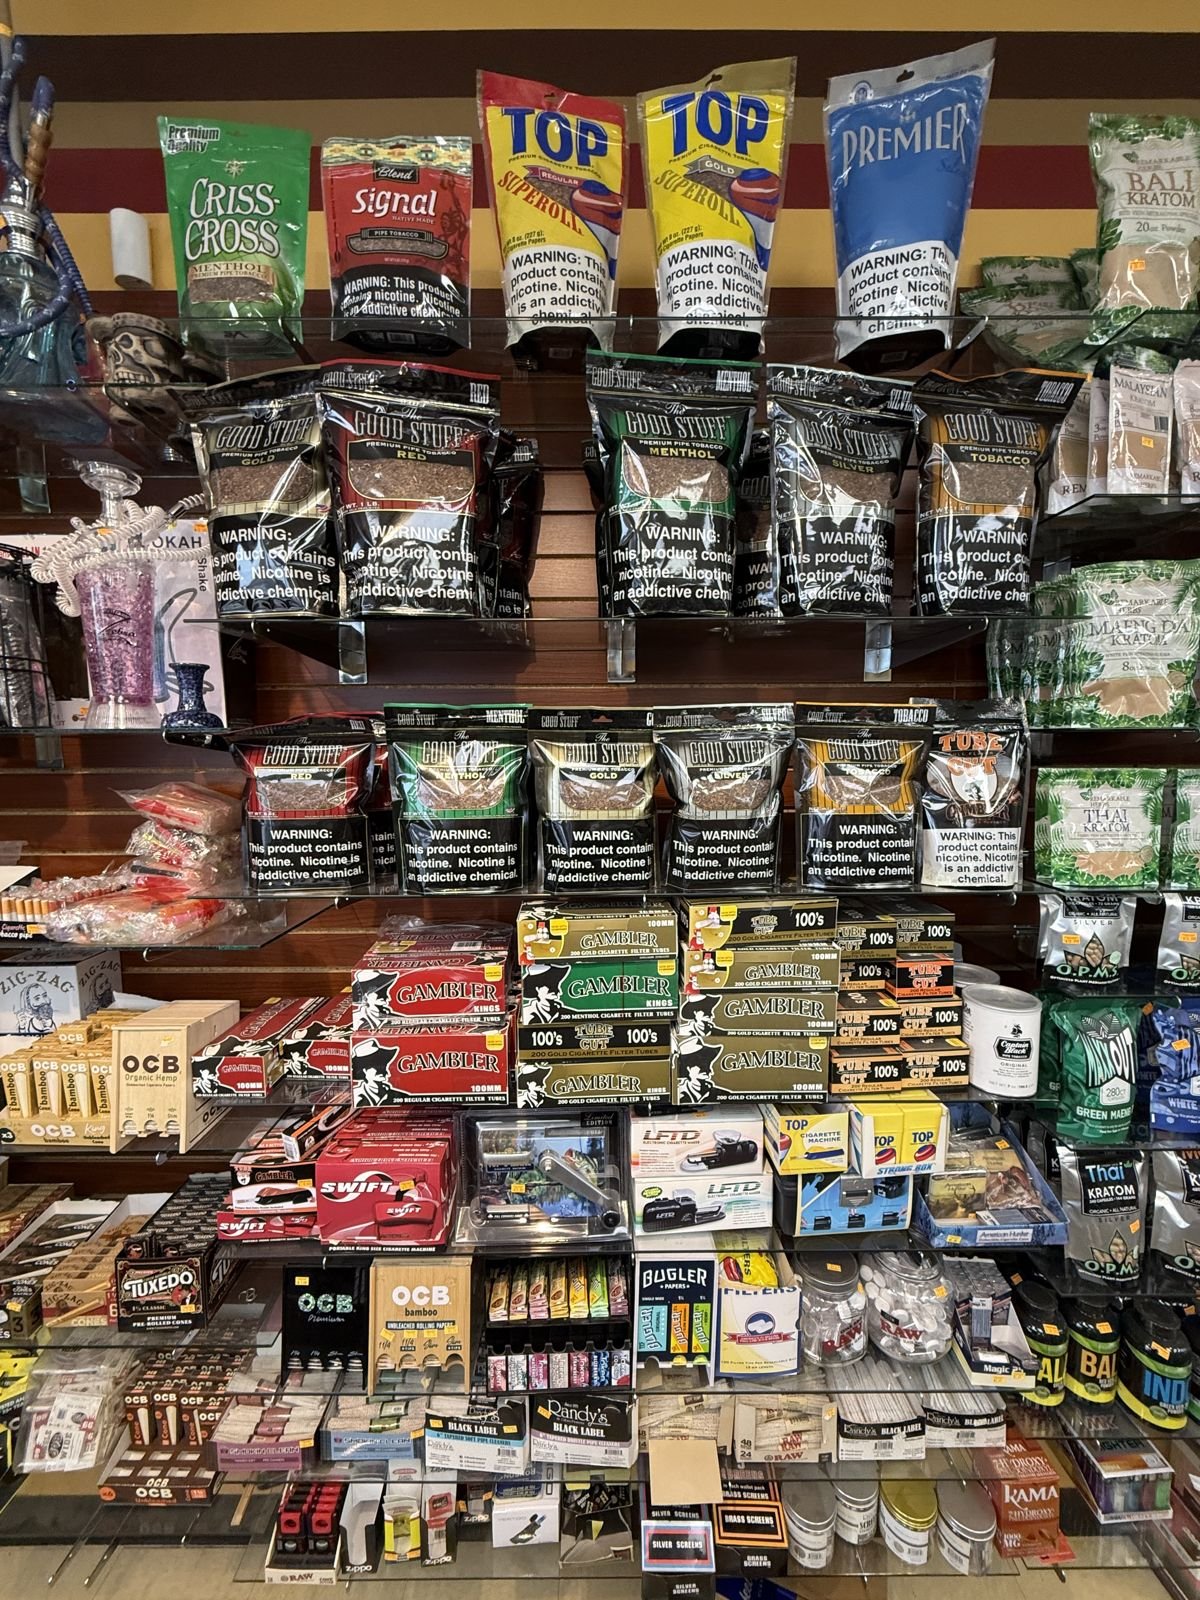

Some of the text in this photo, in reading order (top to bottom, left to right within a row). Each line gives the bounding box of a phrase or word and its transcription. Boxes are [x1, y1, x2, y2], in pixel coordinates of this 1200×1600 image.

[662, 91, 769, 156] TOP
[169, 126, 219, 140] Premium
[501, 107, 608, 166] TOP
[168, 139, 206, 152] Quality
[842, 103, 967, 186] PREMIER
[379, 167, 412, 180] Blend
[705, 160, 735, 175] GOLD
[541, 171, 579, 185] REGULAR
[1129, 170, 1193, 192] BALI
[352, 188, 437, 217] Signal
[497, 170, 584, 236] SUPEROLL
[654, 169, 742, 227] SUPEROLL
[1127, 192, 1194, 209] KRATOM
[184, 218, 280, 260] CROSS
[511, 251, 581, 268] WARNING:
[667, 246, 758, 274] WARNING: This
[850, 249, 927, 280] WARNING:
[511, 266, 557, 291] product
[344, 277, 415, 295] WARNING: This
[1114, 377, 1168, 398] MALAYSIAN
[216, 416, 314, 449] GOOD STUFF
[355, 410, 463, 448] GOOD STUFF
[627, 411, 726, 441] GOOD STUFF
[944, 414, 1041, 447] GOOD STUFF
[691, 442, 723, 450] TOBACCO
[242, 454, 275, 466] GOLD
[396, 450, 427, 462] RED
[649, 448, 715, 460] MENTHOL
[970, 453, 1030, 465] TOBACCO
[832, 459, 874, 474] SILVER
[646, 526, 720, 543] WARNING:
[198, 557, 206, 592] Shake
[1089, 618, 1189, 636] MAENG DA
[486, 710, 525, 724] MENTHOL
[893, 709, 929, 723] TOBACCO
[594, 733, 610, 742] The
[939, 732, 1004, 751] TUBE
[263, 745, 343, 765] GOOD STUFF
[564, 744, 640, 764] GOOD STUFF
[690, 741, 764, 764] GOOD STUFF
[291, 772, 312, 780] RED
[590, 771, 617, 779] GOLD
[1083, 808, 1127, 824] THAI
[270, 829, 333, 839] WARNING:
[430, 829, 491, 839] WARNING:
[573, 831, 633, 841] WARNING:
[702, 830, 758, 840] WARNING:
[840, 824, 897, 834] WARNING:
[940, 832, 1016, 841] WARNING: This
[268, 841, 362, 855] product contains
[405, 842, 517, 856] This product contains
[300, 853, 360, 867] Nicotine is
[258, 868, 364, 880] addictive chemical.
[958, 874, 1006, 884] chemical.
[795, 911, 824, 928] 100's
[581, 931, 658, 950] GAMBLER
[870, 932, 893, 945] 100's
[745, 963, 821, 981] GAMBLER
[909, 964, 942, 975] TUBE
[0, 970, 75, 995] ZIG-ZAG
[567, 975, 670, 999] GAMBLER
[912, 978, 938, 988] CUT
[397, 982, 497, 1004] GAMBLER
[473, 1004, 500, 1013] KINGS
[646, 999, 673, 1007] KINGS
[724, 997, 825, 1019] GAMBLER
[571, 1013, 596, 1021] MENTHOL
[575, 1024, 613, 1036] TUBE
[59, 1034, 84, 1043] OCB
[531, 1031, 563, 1046] 100's
[579, 1038, 609, 1050] CUT
[34, 1060, 58, 1071] OCB
[123, 1055, 179, 1073] OCB
[397, 1052, 499, 1074] GAMBLER
[720, 1049, 822, 1073] GAMBLER
[942, 1061, 966, 1073] 100's
[125, 1074, 178, 1083] Organic Hemp
[551, 1074, 641, 1096] GAMBLER
[236, 1082, 263, 1090] 100MM
[470, 1084, 502, 1093] 100MM
[792, 1083, 823, 1091] 100MM
[1168, 1098, 1198, 1110] WHITE
[1076, 1106, 1108, 1120] GREEN
[30, 1124, 76, 1137] OCB
[786, 1120, 808, 1130] TOP
[801, 1131, 841, 1139] CIGARETTE
[912, 1132, 934, 1142] TOP
[255, 1170, 295, 1182] GAMBLER
[1085, 1162, 1125, 1182] Thai
[320, 1179, 392, 1194] SWIFT
[1088, 1185, 1135, 1199] KRATOM
[219, 1222, 266, 1232] SWIFT
[643, 1267, 707, 1287] BUGLER
[124, 1271, 193, 1298] TUXEDO
[391, 1285, 449, 1306] OCB
[297, 1293, 353, 1313] OCB
[404, 1308, 438, 1317] bamboo
[71, 1318, 107, 1326] CONES
[880, 1320, 922, 1341] RAW
[984, 1365, 1010, 1373] Magic
[125, 1395, 148, 1404] OCB
[153, 1393, 177, 1402] OCB
[547, 1400, 608, 1426] Randy's
[448, 1422, 498, 1436] BLACK LABEL
[553, 1424, 606, 1438] BLACK LABEL
[774, 1452, 804, 1461] RAW
[136, 1488, 173, 1499] OCB
[724, 1515, 774, 1525] BRASS SCREENS
[676, 1541, 703, 1549] SCREENS
[290, 1573, 313, 1582] RAW
